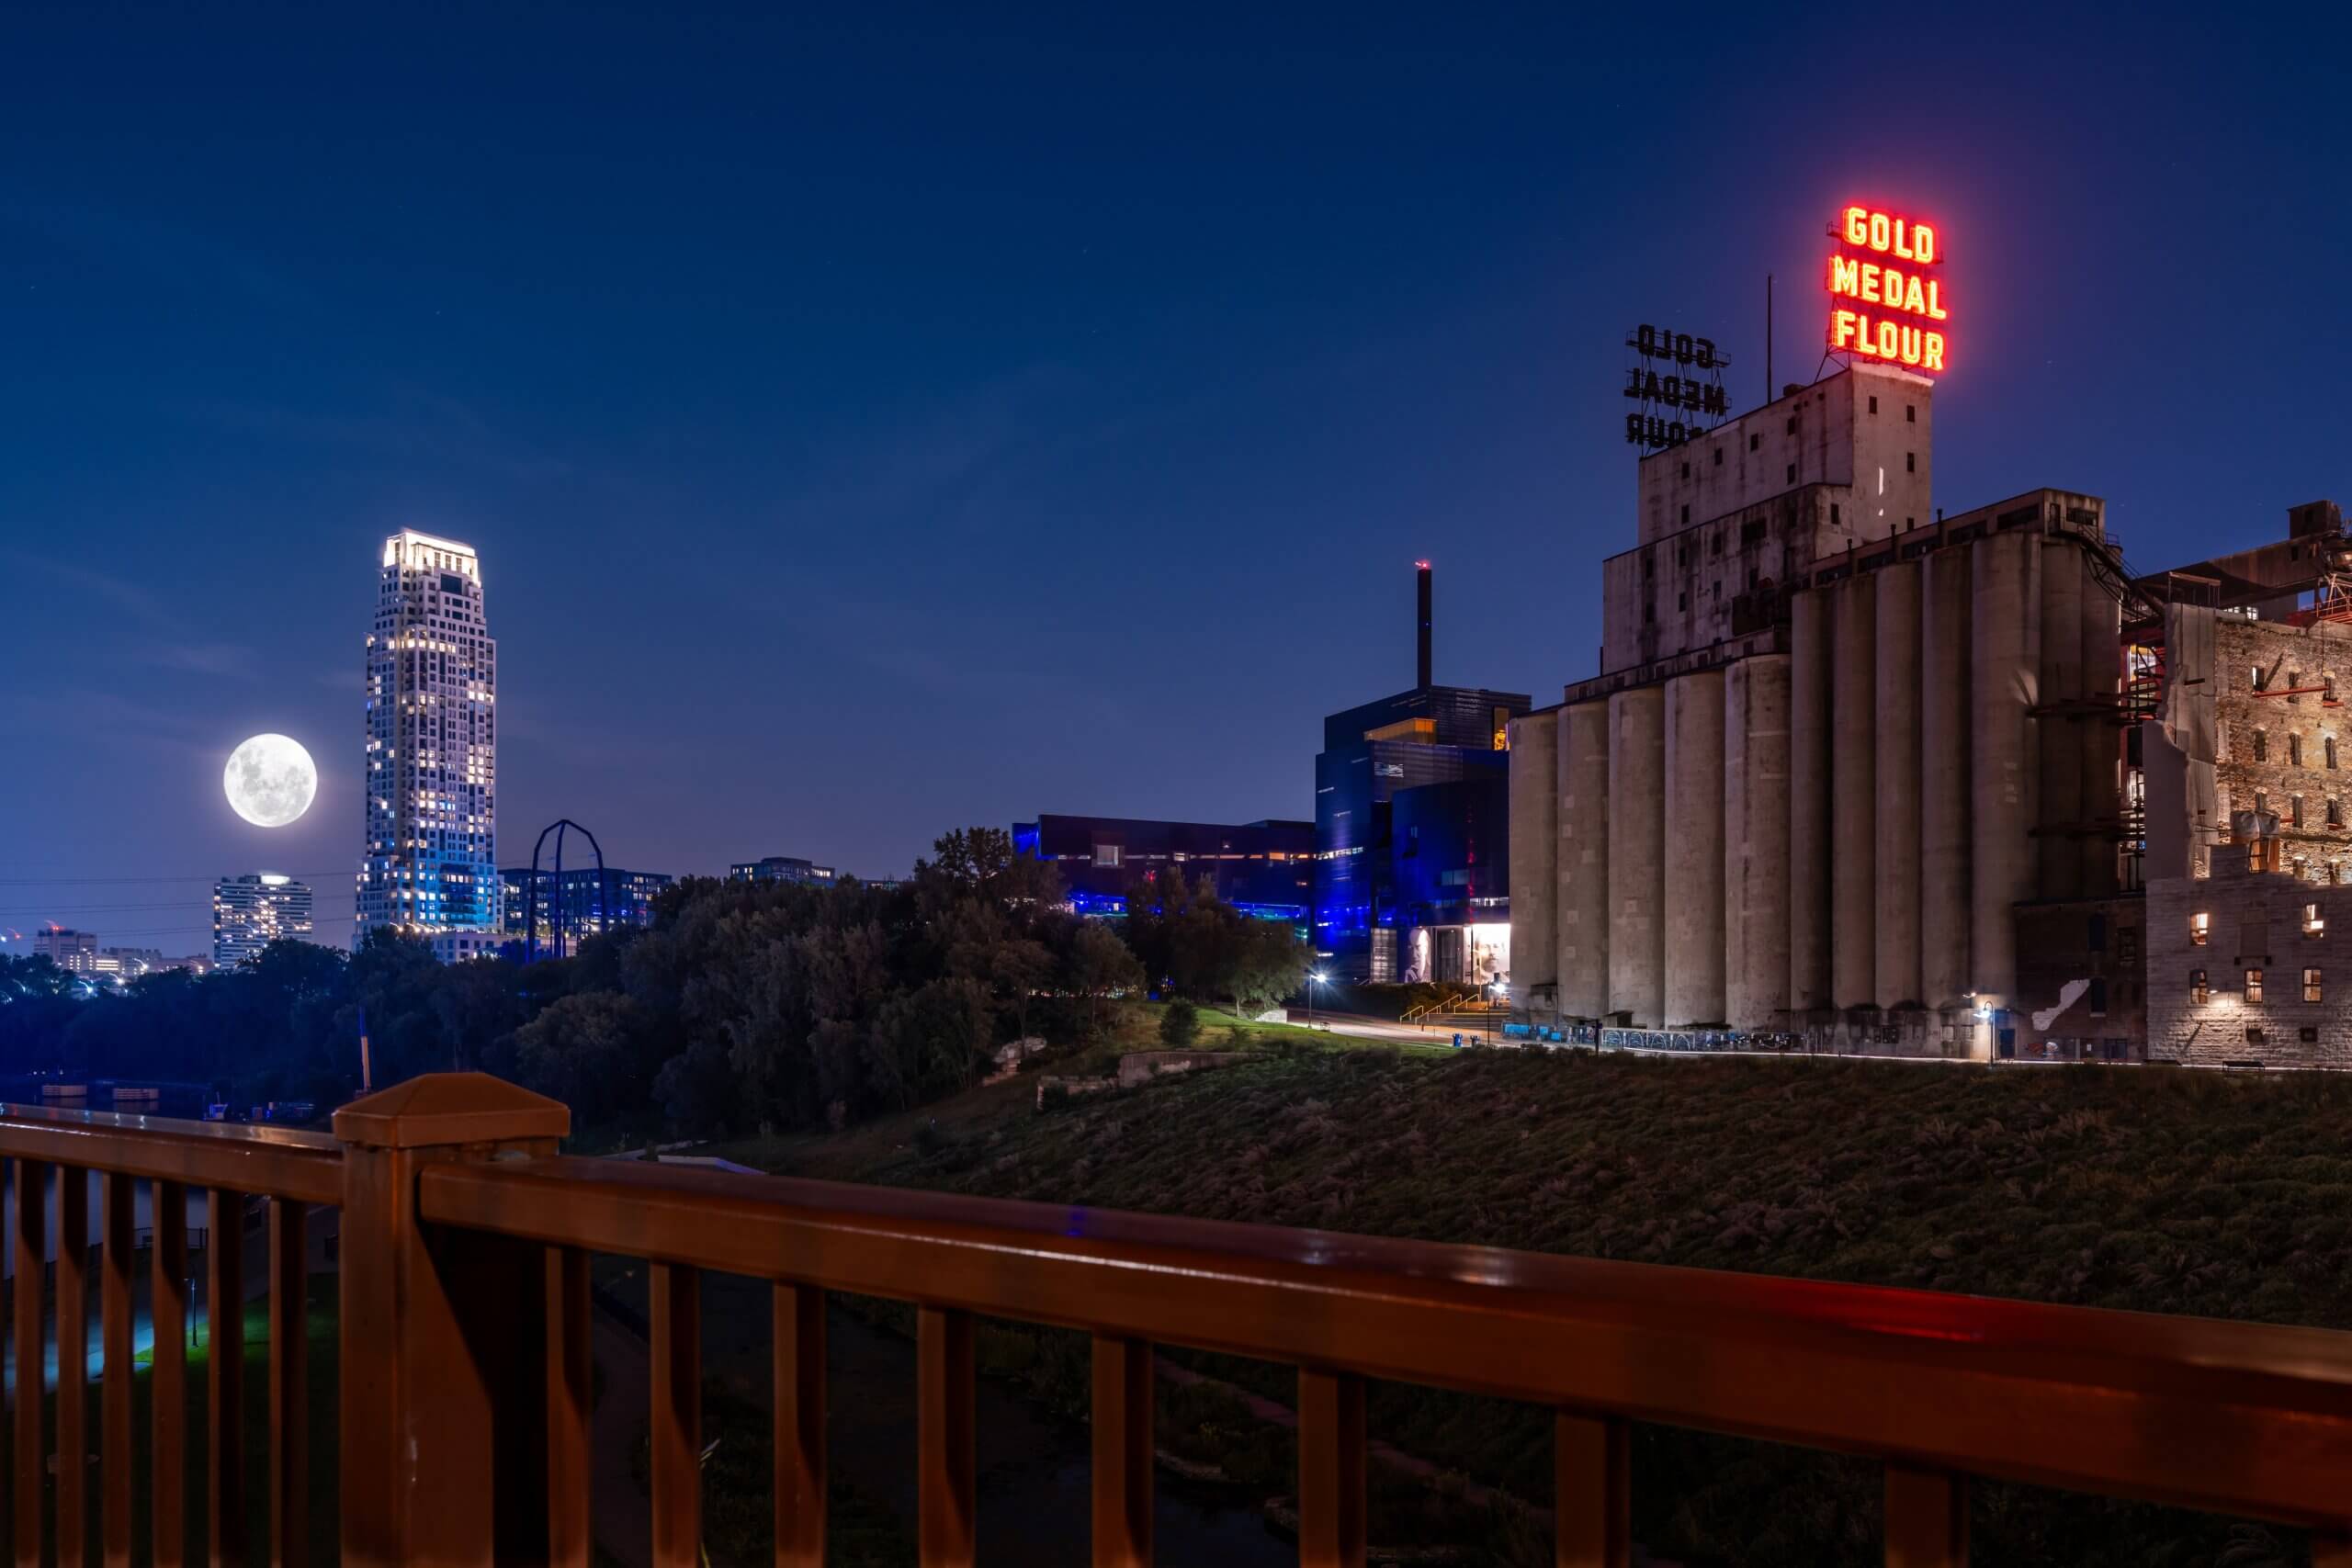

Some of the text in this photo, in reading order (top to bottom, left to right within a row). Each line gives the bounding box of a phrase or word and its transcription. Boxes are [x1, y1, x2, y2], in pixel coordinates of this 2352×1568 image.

[1844, 207, 1934, 264] GOLD
[1830, 254, 1947, 320] MEDAL
[1833, 309, 1944, 371] FLOUR
